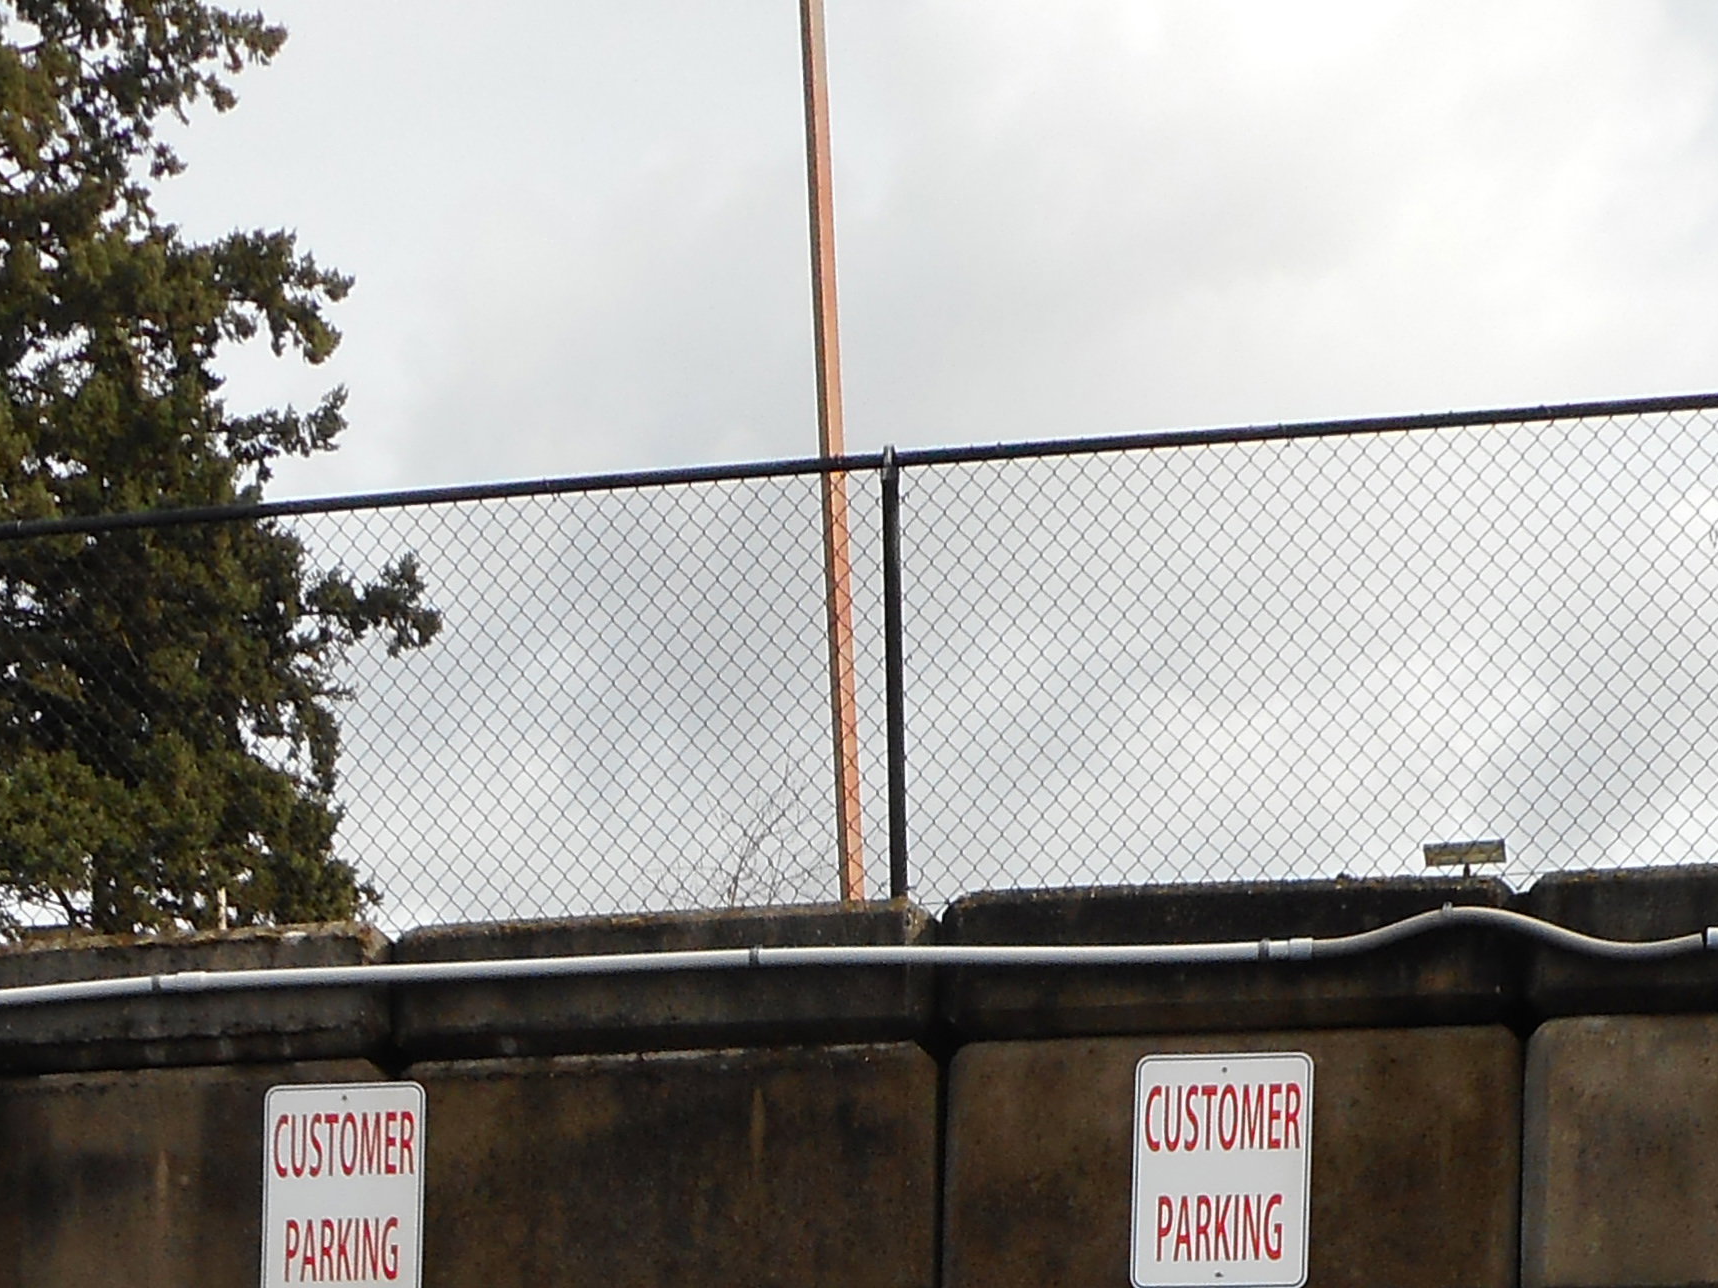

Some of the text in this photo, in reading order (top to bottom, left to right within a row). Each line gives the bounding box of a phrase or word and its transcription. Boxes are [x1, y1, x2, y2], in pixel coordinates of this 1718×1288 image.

[275, 1110, 417, 1179] CUSTOMER
[1144, 1082, 1303, 1152] CUSTOMER
[285, 1216, 400, 1281] PARKING
[1156, 1193, 1284, 1260] PARKING
